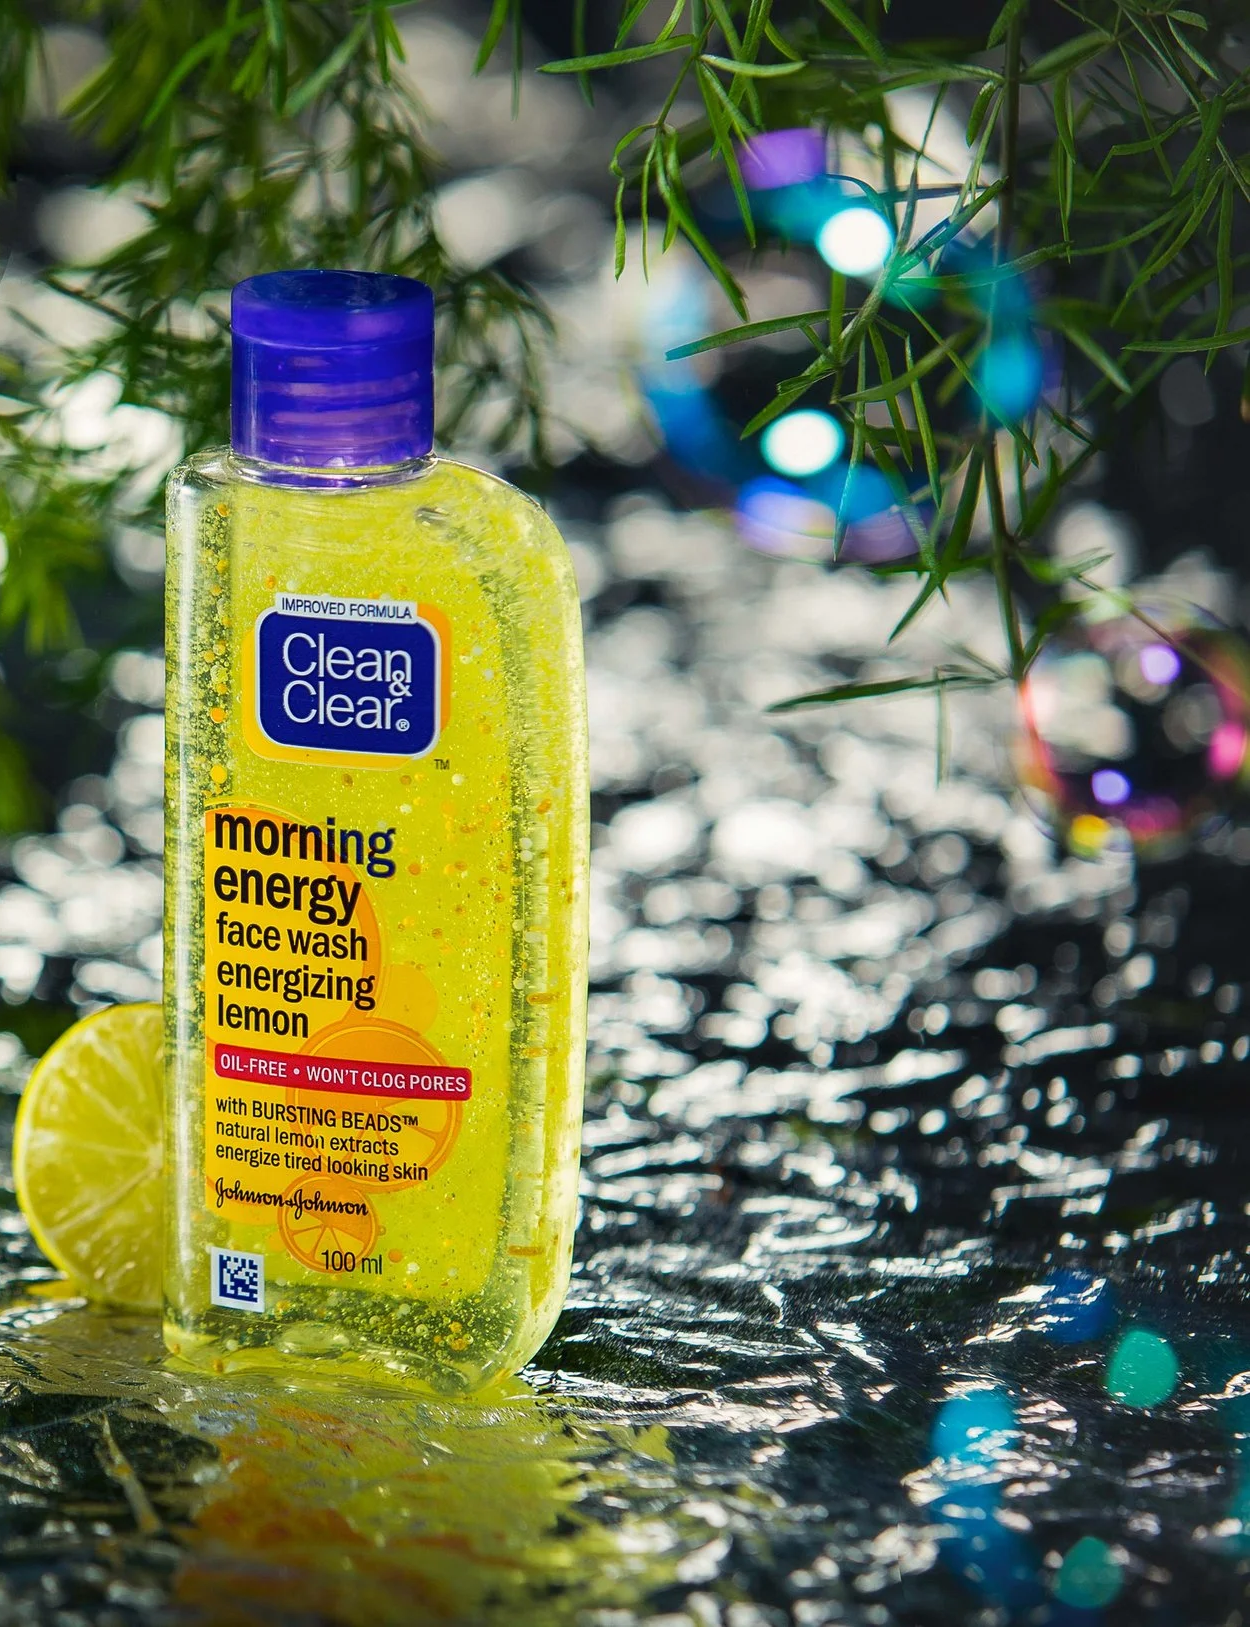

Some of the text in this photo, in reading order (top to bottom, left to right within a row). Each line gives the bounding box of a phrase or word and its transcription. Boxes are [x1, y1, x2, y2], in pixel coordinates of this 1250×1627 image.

[282, 598, 412, 619] IMPROVED FORMULA
[282, 632, 412, 683] Clean
[388, 670, 413, 697] &
[214, 812, 396, 879] morning
[214, 864, 362, 926] energy
[216, 911, 368, 961] face wash
[217, 959, 376, 1011] energizing
[217, 994, 309, 1038] lemon
[220, 1053, 287, 1078] OIL-FREE
[361, 1071, 406, 1090] CLOG
[410, 1075, 467, 1093] PORES
[216, 1097, 248, 1116] with
[252, 1100, 337, 1127] BURSTING
[216, 1120, 399, 1156] natural lemon extracts
[216, 1143, 429, 1181] energize tired looking skin
[321, 1249, 383, 1275] 100 ml
